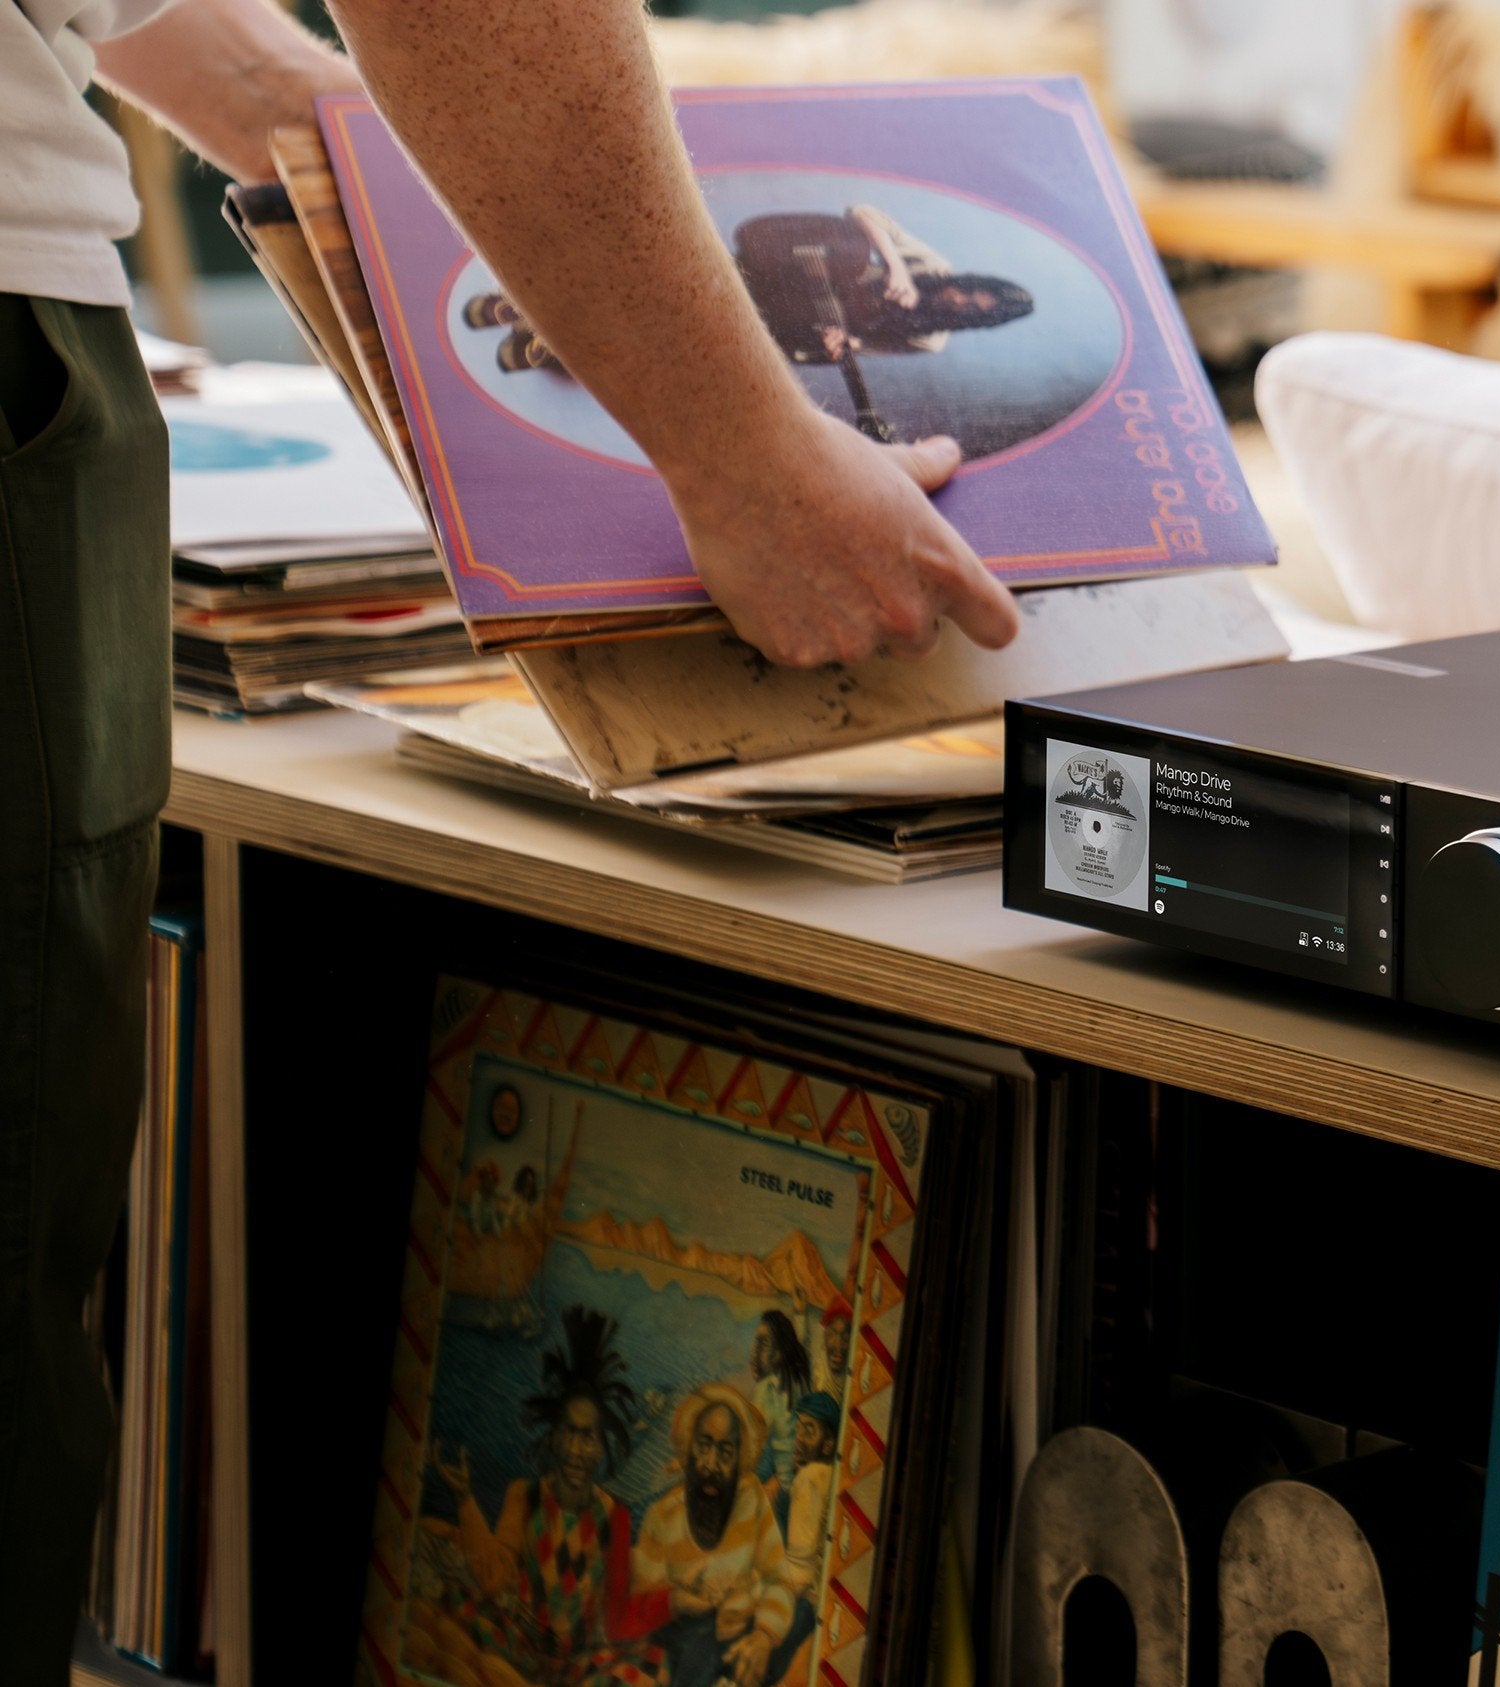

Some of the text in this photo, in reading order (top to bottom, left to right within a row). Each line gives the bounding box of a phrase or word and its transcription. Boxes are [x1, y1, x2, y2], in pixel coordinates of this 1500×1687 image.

[1156, 762, 1231, 791] Mango Drive
[1156, 782, 1232, 809] Rhythm & Sound
[1155, 800, 1181, 814] Mango
[1204, 810, 1230, 824] Mango
[1231, 815, 1250, 828] Drive
[1326, 940, 1345, 952] 13:36
[740, 1166, 834, 1209] STEEL PULSE
